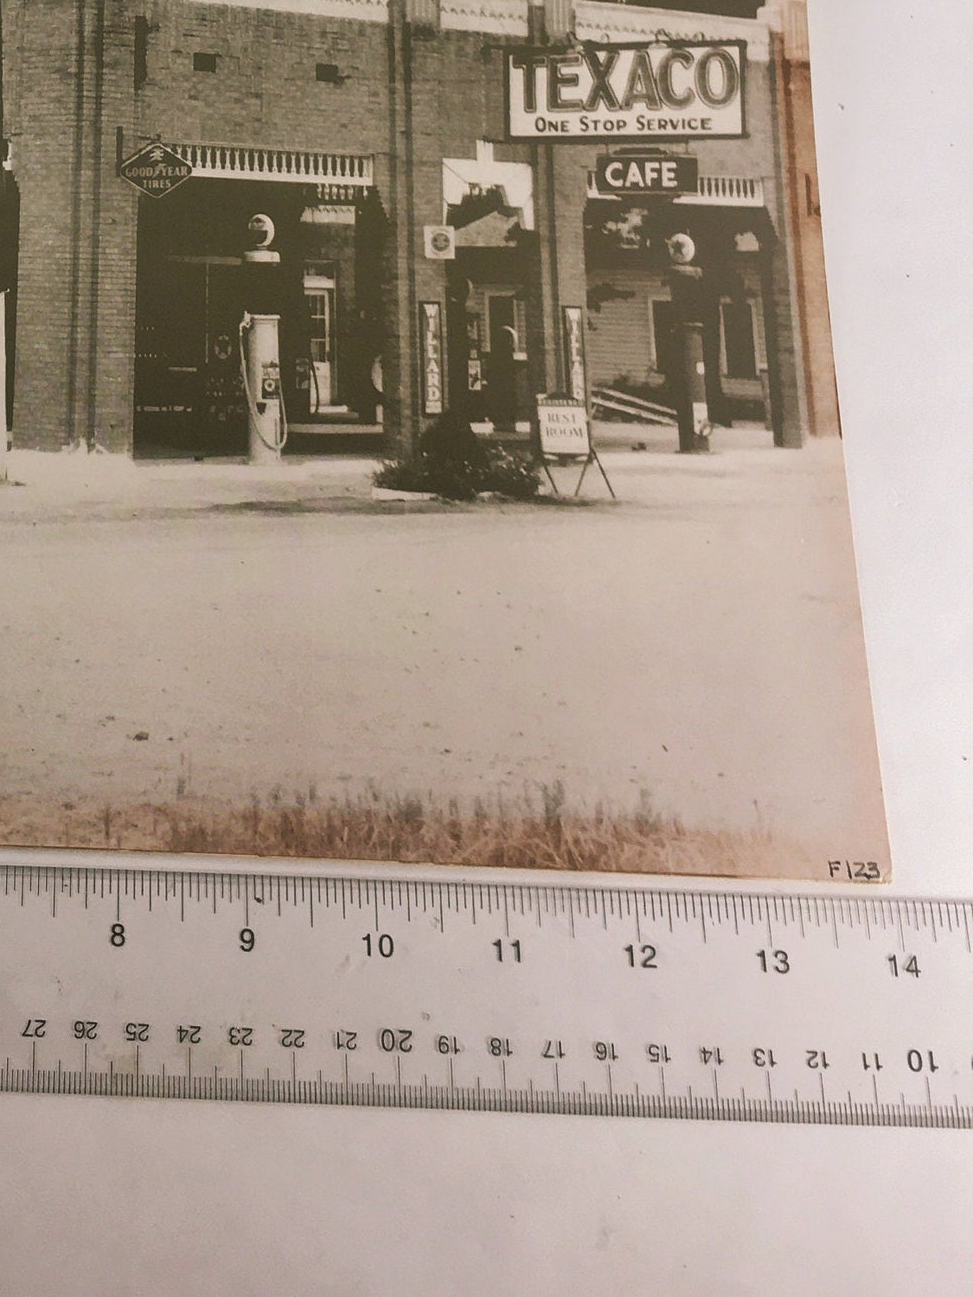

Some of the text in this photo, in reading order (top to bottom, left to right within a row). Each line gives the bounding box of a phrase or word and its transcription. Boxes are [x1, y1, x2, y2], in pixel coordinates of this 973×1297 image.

[512, 48, 740, 113] TEXACO
[534, 115, 713, 133] ONE STOP SERVICE
[142, 179, 172, 189] TIRES
[604, 161, 678, 188] CAFE
[422, 303, 441, 401] WILLARD
[109, 923, 125, 947] 8
[239, 928, 255, 952] 9
[362, 933, 394, 958] 10
[492, 939, 521, 963] 11
[623, 944, 657, 969] 12
[756, 950, 790, 974] 13
[887, 954, 921, 978] 14
[20, 1019, 46, 1038] 27
[72, 1021, 98, 1040] 26
[126, 1023, 149, 1042] 25
[176, 1025, 201, 1044] 24
[227, 1026, 253, 1046] 23
[278, 1029, 305, 1048] 22
[333, 1029, 357, 1050] 21
[377, 1028, 412, 1053] 20
[435, 1035, 461, 1055] 19
[487, 1037, 513, 1057] 18
[541, 1040, 565, 1059] 17
[592, 1042, 619, 1061] 16
[645, 1044, 671, 1063] 15
[699, 1047, 724, 1066] 14
[752, 1048, 777, 1068] 13
[806, 1050, 830, 1069] 12
[862, 1052, 883, 1071] 11
[907, 1049, 939, 1073] 10
